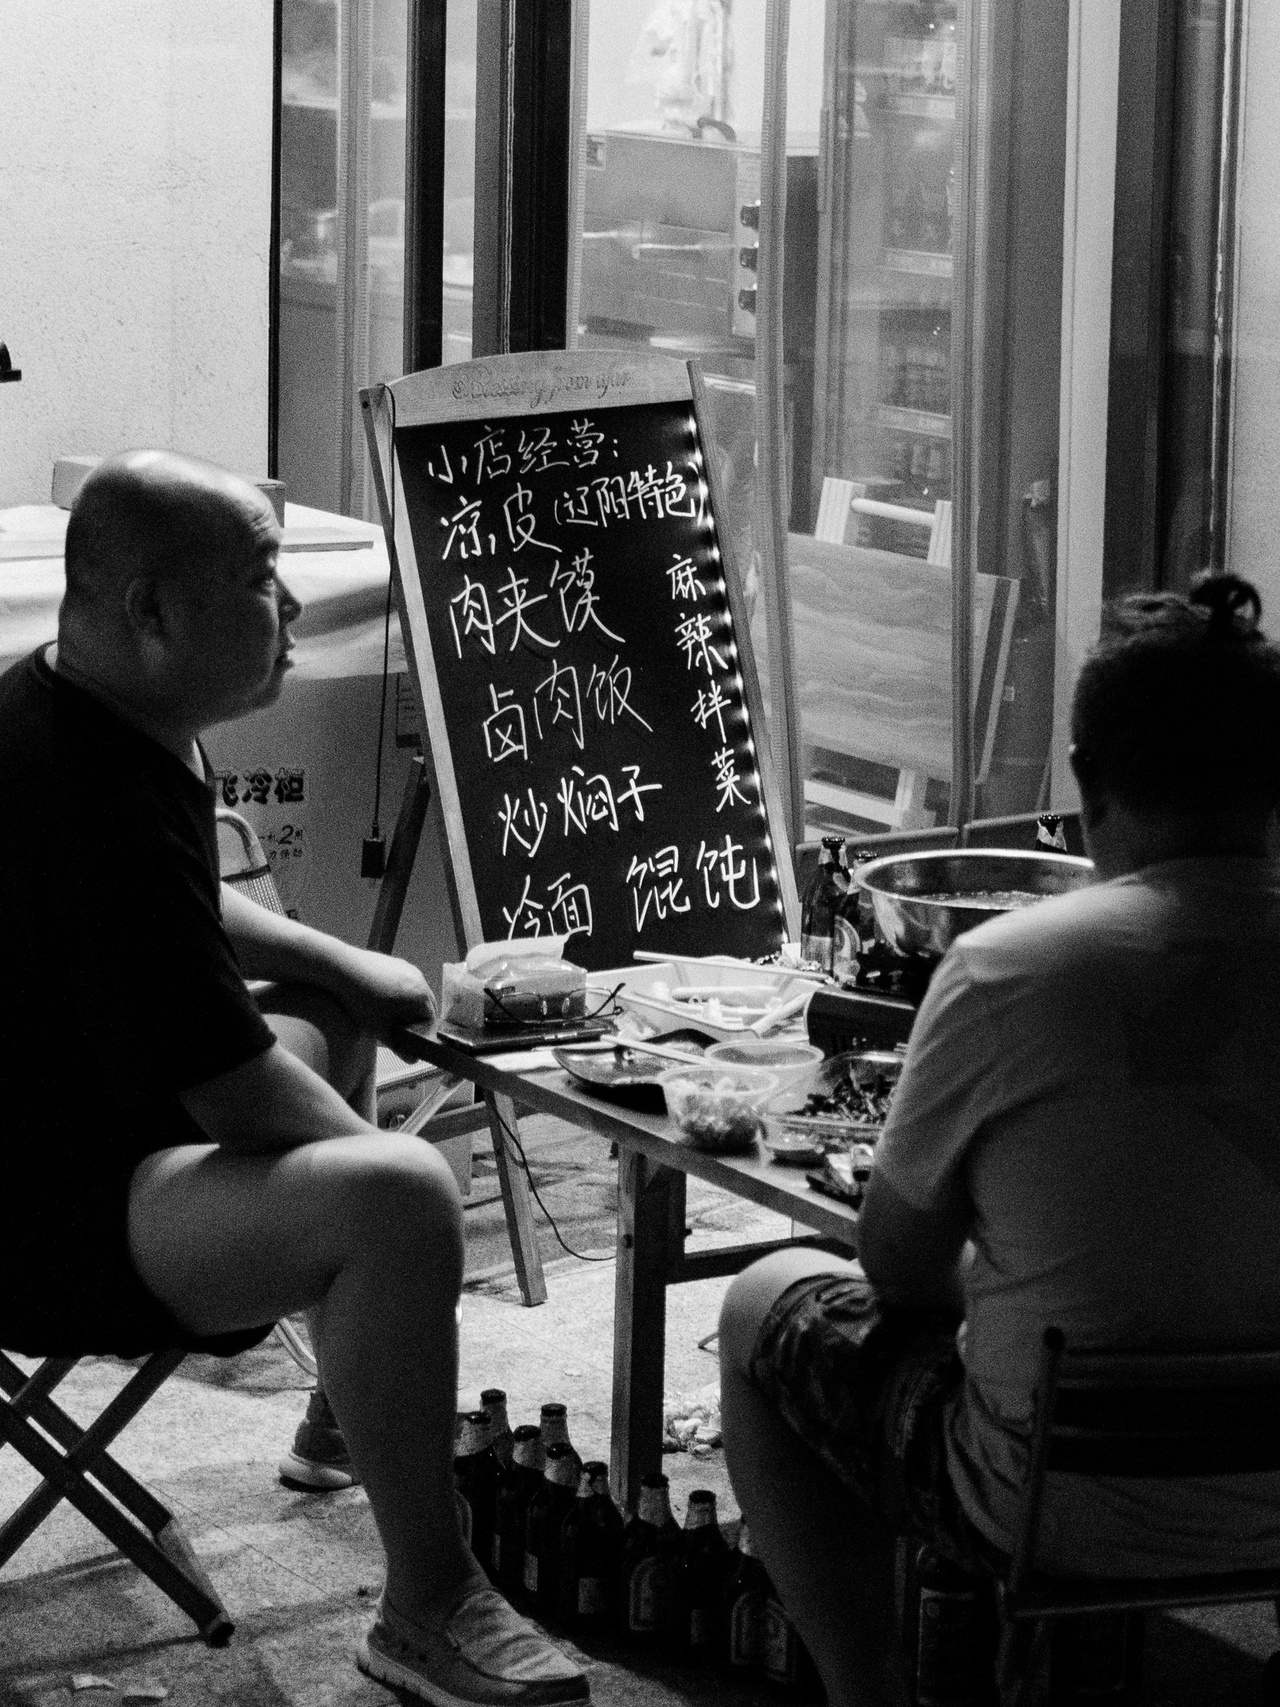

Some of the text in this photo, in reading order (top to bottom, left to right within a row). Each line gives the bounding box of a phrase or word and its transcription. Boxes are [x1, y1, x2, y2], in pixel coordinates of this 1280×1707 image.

[440, 482, 563, 560] 凉皮
[450, 547, 626, 660] 肉夹馍
[483, 654, 654, 762] 卤肉饭
[498, 765, 663, 858] 炒焖子
[502, 872, 593, 941] 冷面
[626, 834, 760, 932] 馄饨
